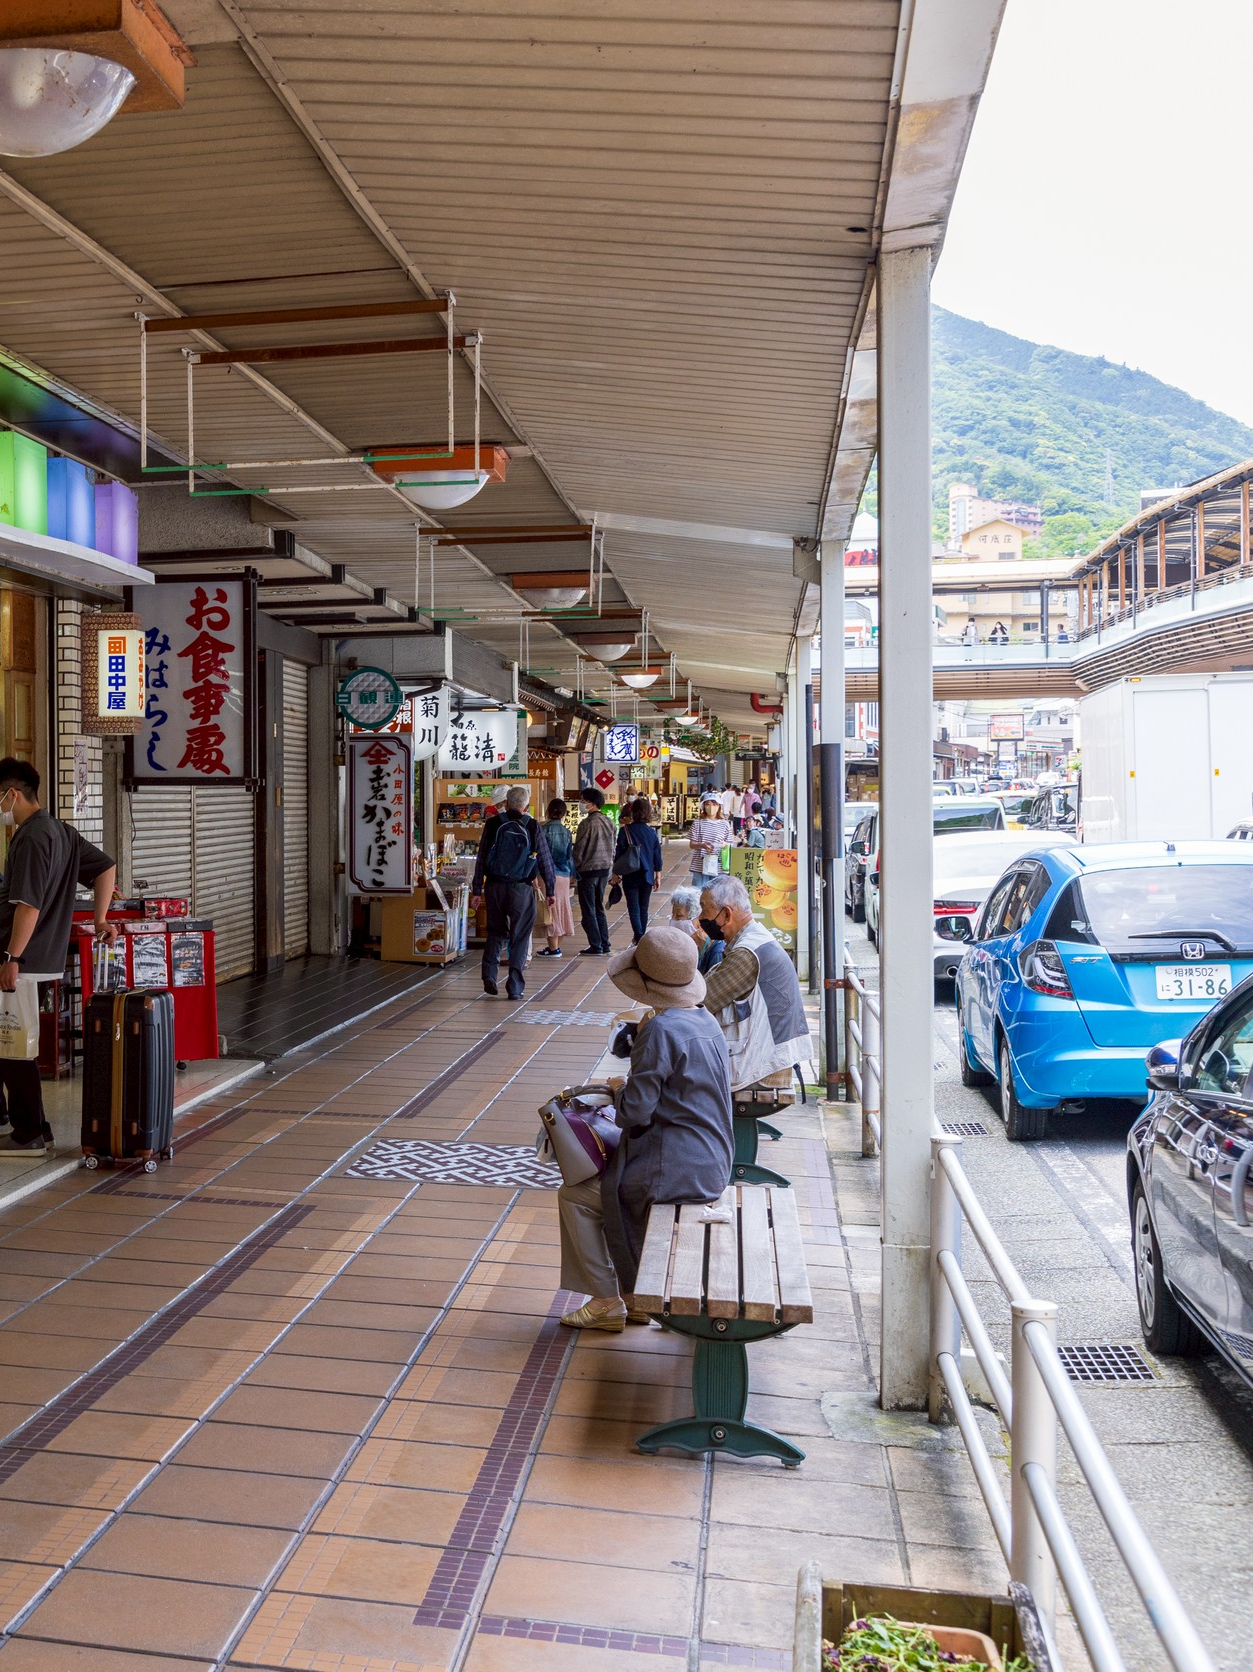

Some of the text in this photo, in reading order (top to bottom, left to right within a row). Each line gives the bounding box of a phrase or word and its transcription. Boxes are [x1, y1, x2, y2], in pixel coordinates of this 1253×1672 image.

[107, 655, 127, 710] 田中屋
[145, 627, 172, 771] みはらし
[418, 695, 440, 746] 菊川
[449, 733, 496, 763] 籠清
[391, 763, 405, 836] 小田原の味
[1162, 978, 1228, 996] に 31-86
